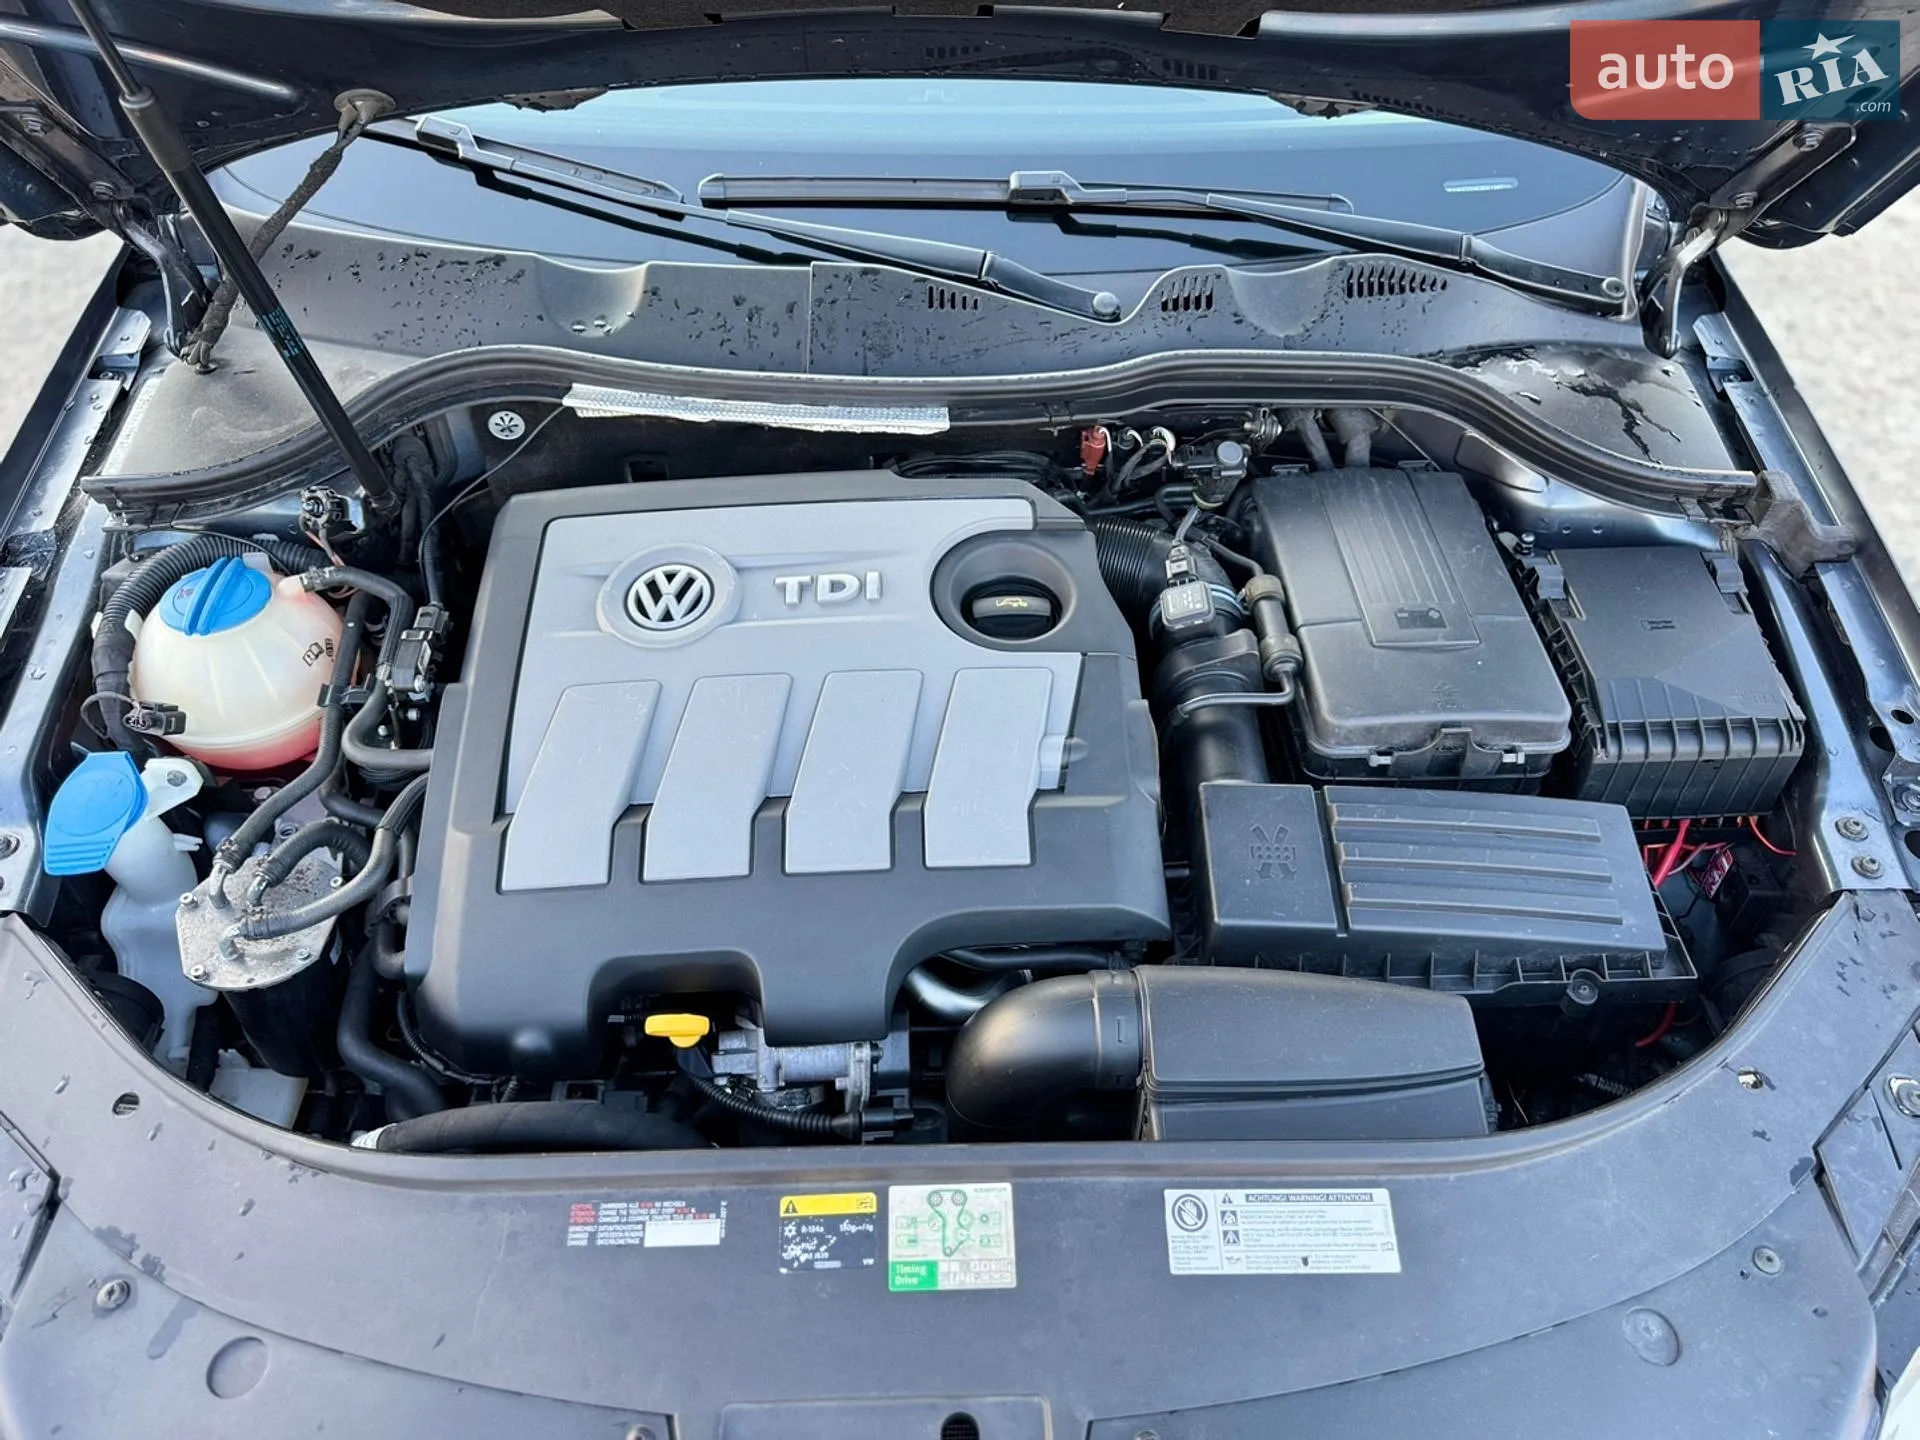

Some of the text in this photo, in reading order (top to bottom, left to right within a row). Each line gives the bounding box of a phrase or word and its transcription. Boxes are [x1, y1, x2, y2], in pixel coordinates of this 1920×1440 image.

[626, 563, 713, 631] VW
[774, 570, 883, 605] TDI
[895, 1264, 928, 1277] Timing
[895, 1275, 918, 1285] Drive
